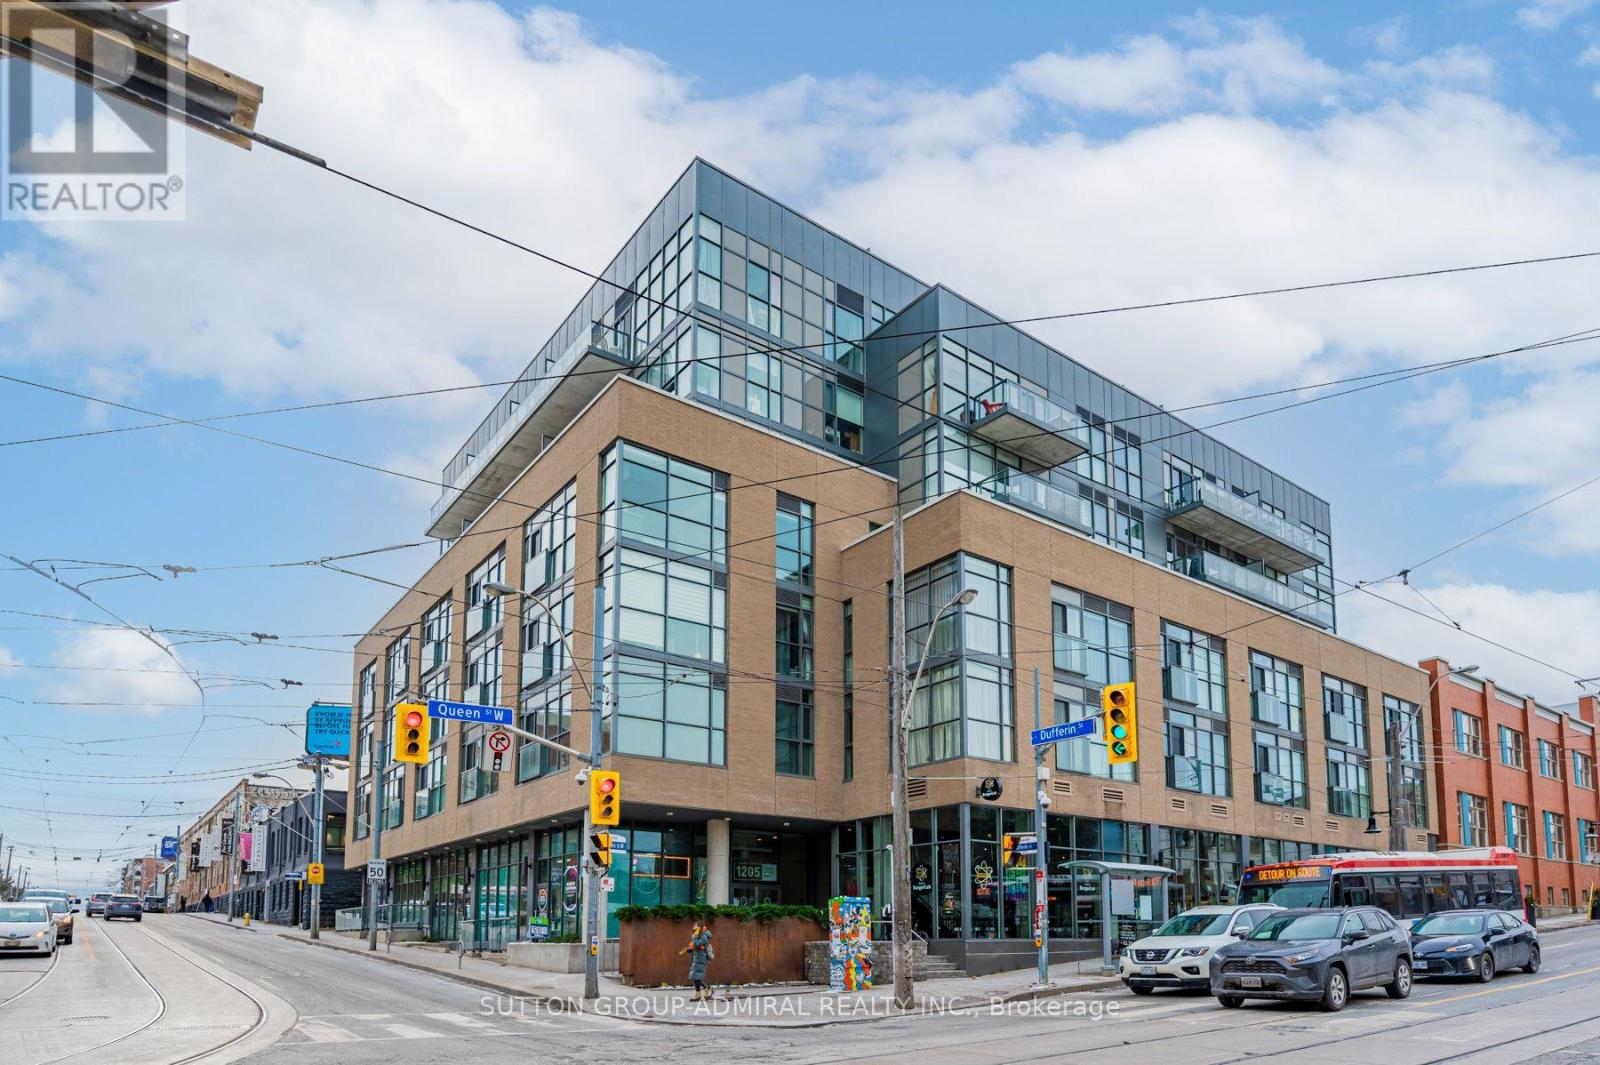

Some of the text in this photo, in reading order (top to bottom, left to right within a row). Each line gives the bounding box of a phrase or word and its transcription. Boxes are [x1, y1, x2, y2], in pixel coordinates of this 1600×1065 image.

[438, 704, 480, 719] Queen
[494, 709, 504, 721] W
[1040, 725, 1077, 740] Dufferin
[370, 867, 383, 878] 50
[736, 866, 761, 878] 1205
[1259, 866, 1320, 880] DETOUR ON ROUTE
